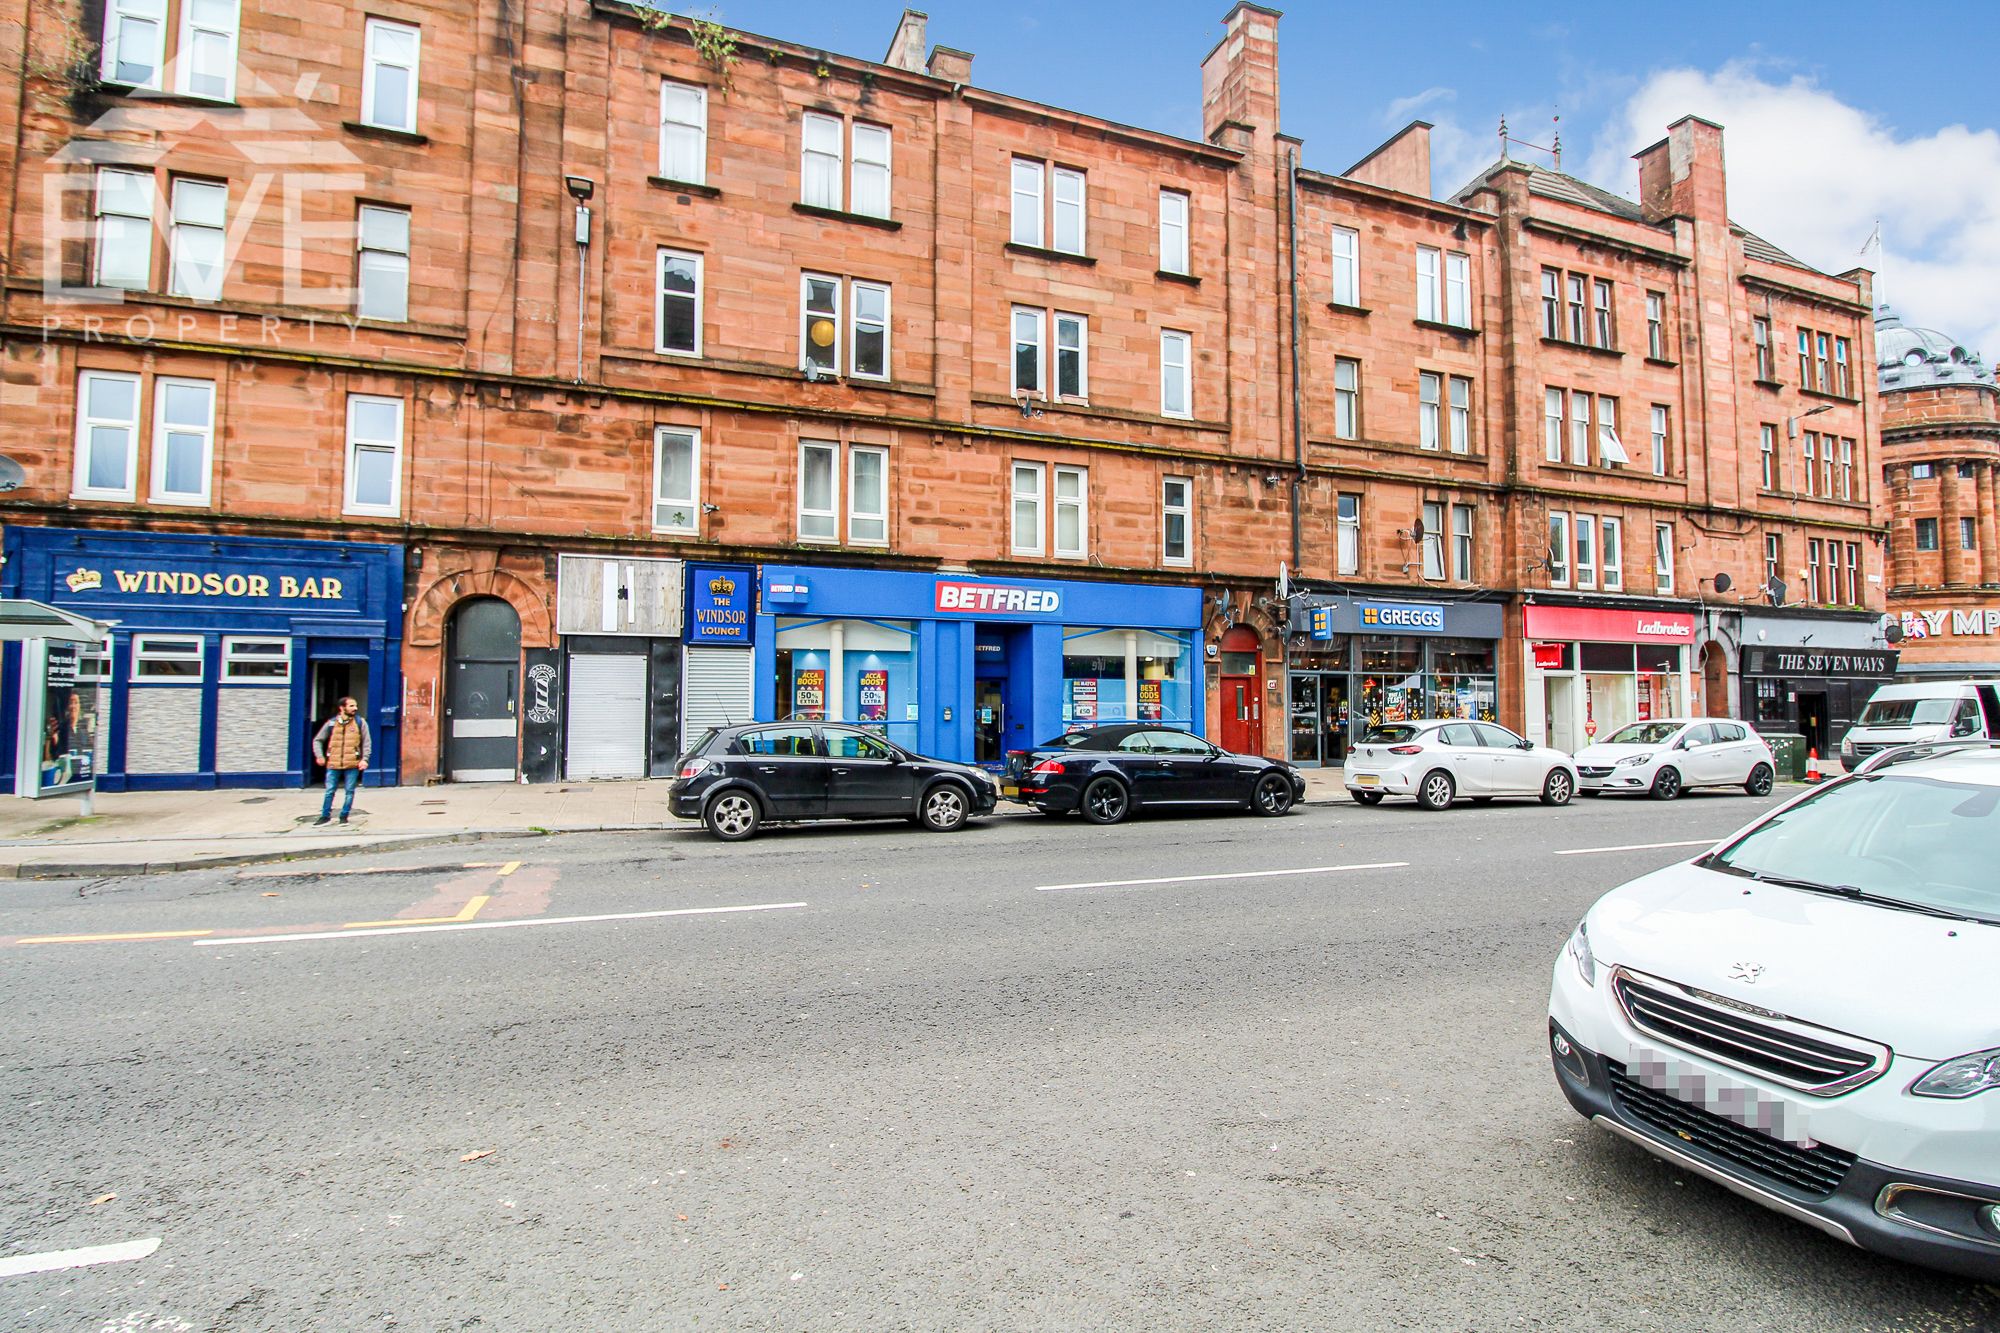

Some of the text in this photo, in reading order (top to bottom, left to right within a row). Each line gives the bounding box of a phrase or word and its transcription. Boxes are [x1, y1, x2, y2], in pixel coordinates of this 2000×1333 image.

[113, 570, 343, 599] WINDSOR BAR
[713, 597, 731, 607] THE
[939, 585, 1060, 613] BETFRED
[696, 609, 746, 624] WINDSOR
[1380, 608, 1442, 627] GREGGS
[701, 626, 741, 636] LOUNGE
[1636, 619, 1690, 637] Ladbrokes
[1778, 654, 1885, 672] THE SEVEN WAYS
[1139, 691, 1160, 699] ODDS
[1140, 684, 1158, 692] BEST
